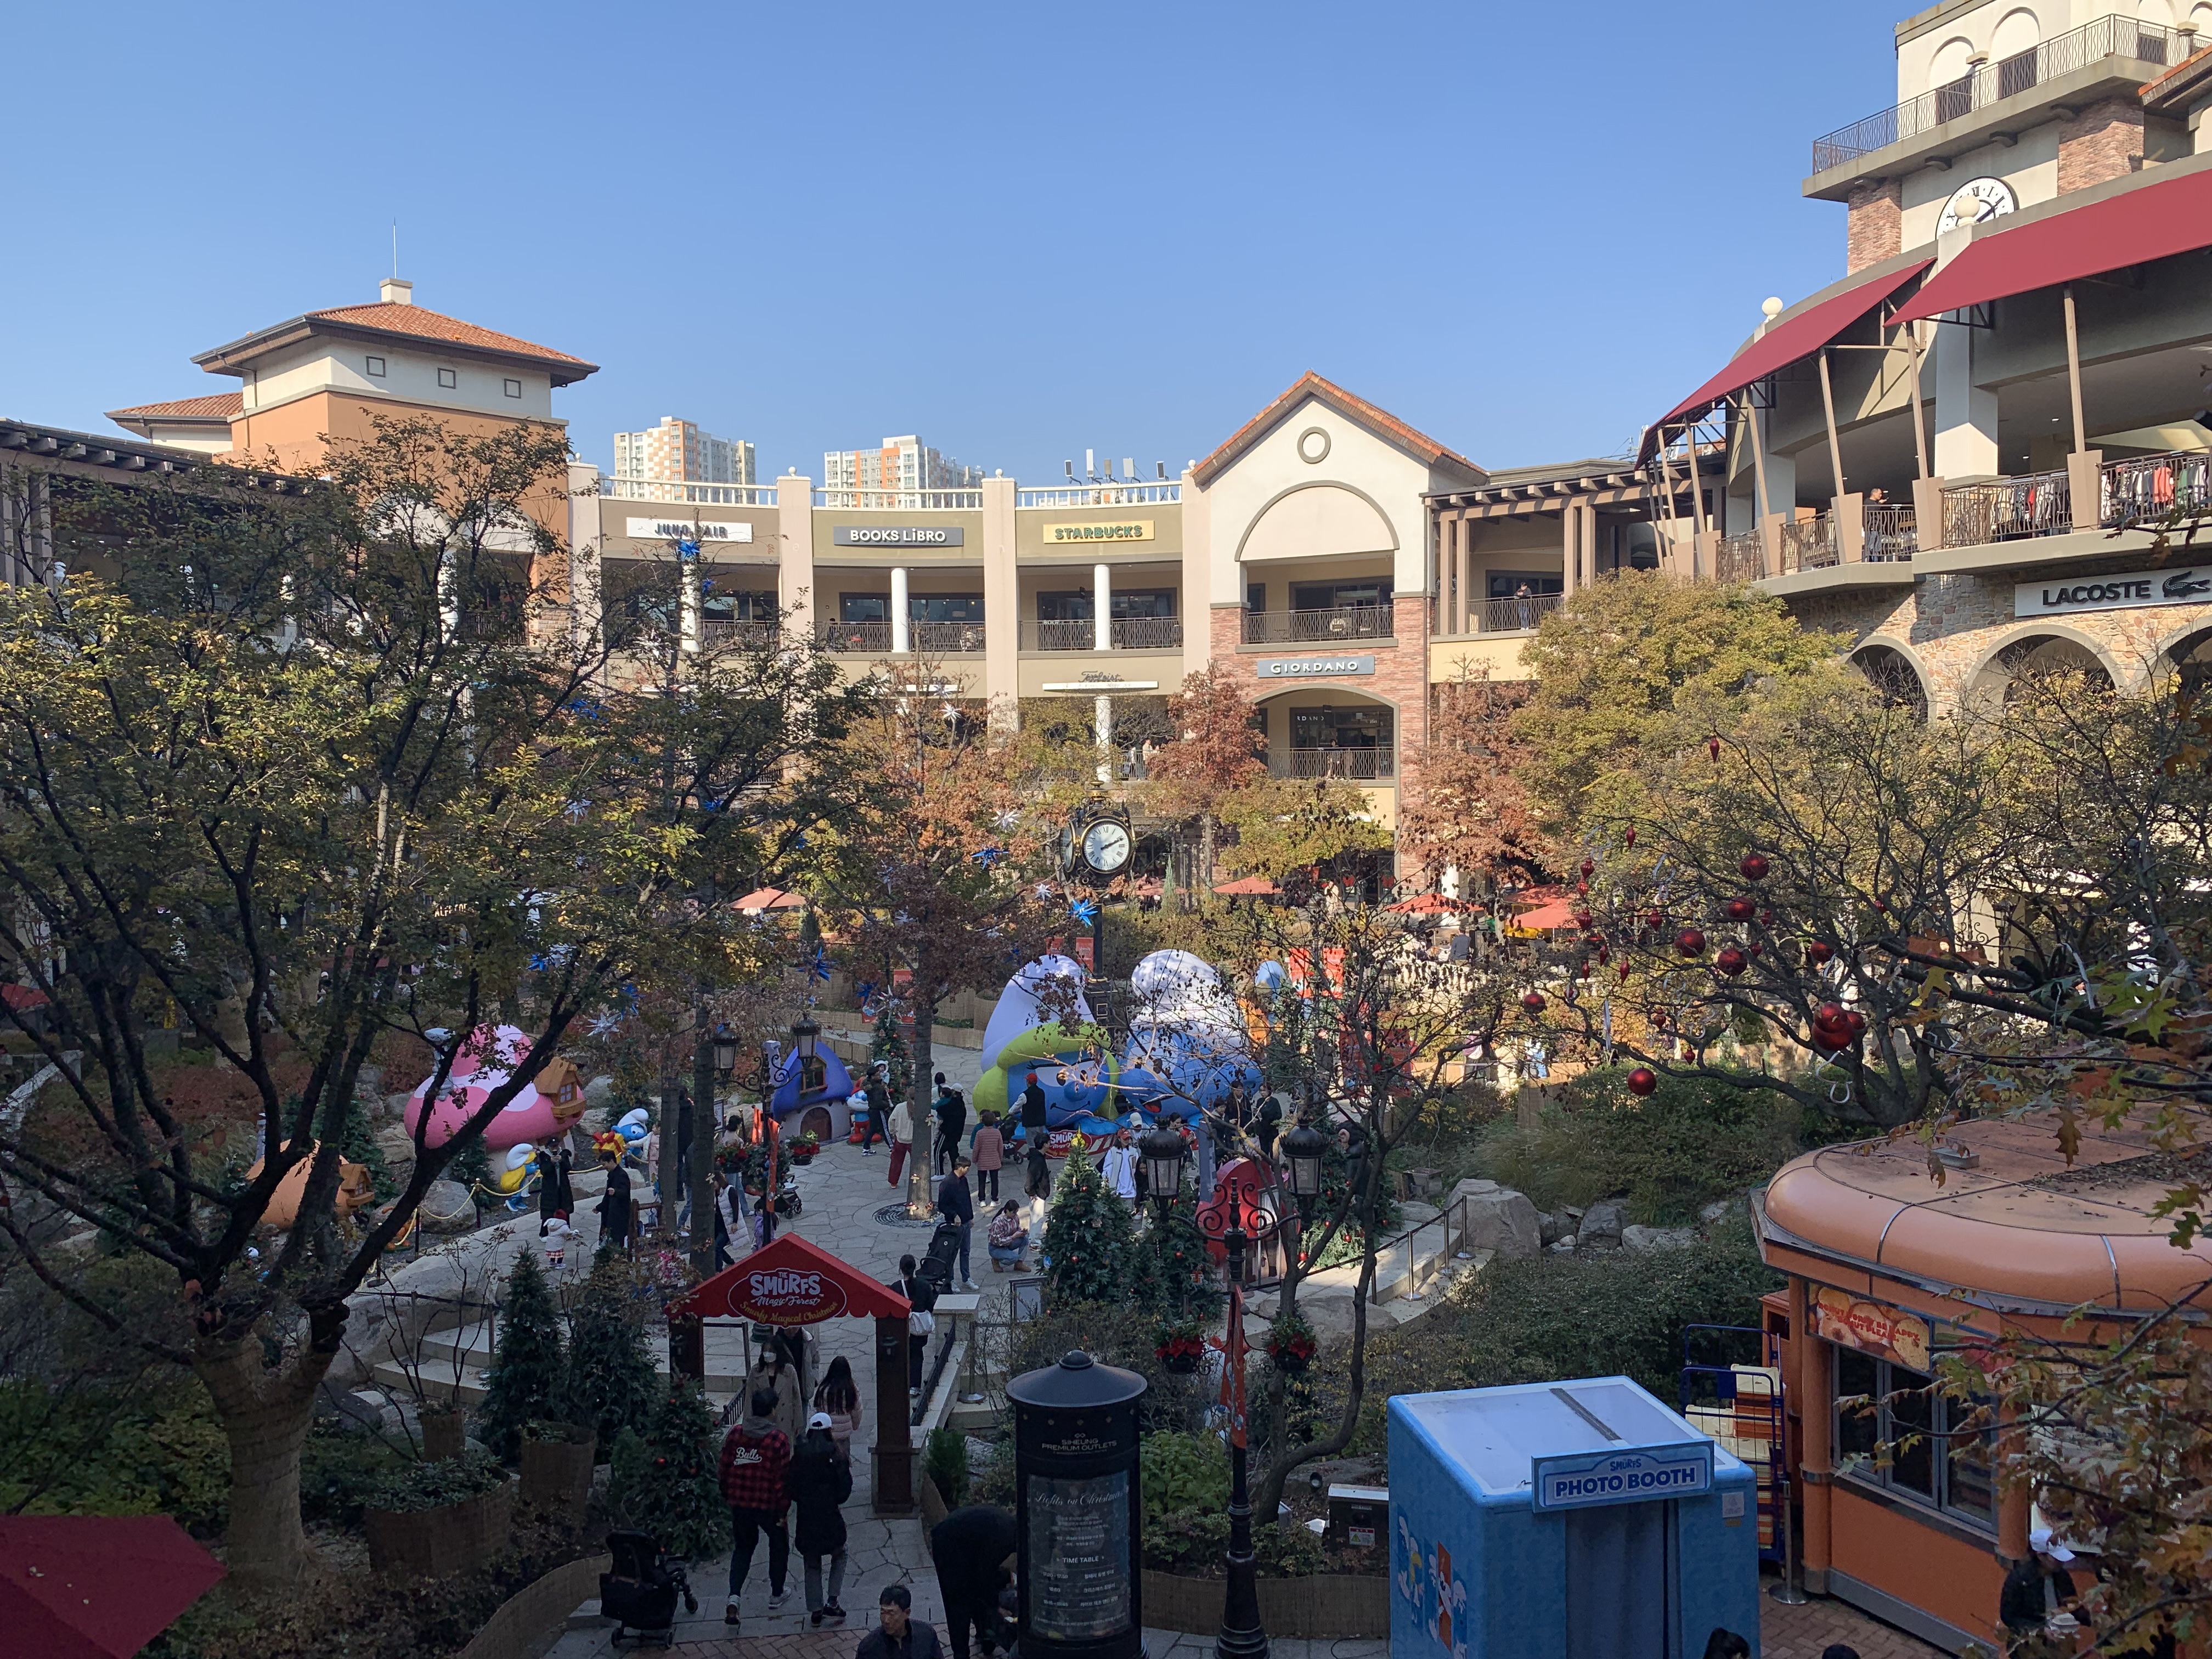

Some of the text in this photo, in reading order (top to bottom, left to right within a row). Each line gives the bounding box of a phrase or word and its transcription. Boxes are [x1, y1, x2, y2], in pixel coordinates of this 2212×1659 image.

[850, 530, 899, 541] BOOKS
[1055, 525, 1142, 540] STARBUCKS
[2042, 580, 2151, 606] LACOSTE
[1271, 661, 1358, 674] GIORDANO
[750, 1273, 821, 1296] SMURFS
[751, 1296, 821, 1307] Magic Forest
[740, 1301, 839, 1327] Smurfy Magical Christmas
[1042, 1440, 1117, 1451] PREMIUM OUTLETS
[736, 1447, 759, 1460] Bulls
[1610, 1458, 1641, 1471] SMURFS
[1555, 1467, 1695, 1498] PHOTO BOOTH
[1036, 1492, 1063, 1507] Lights
[1080, 1491, 1124, 1505] Christmas
